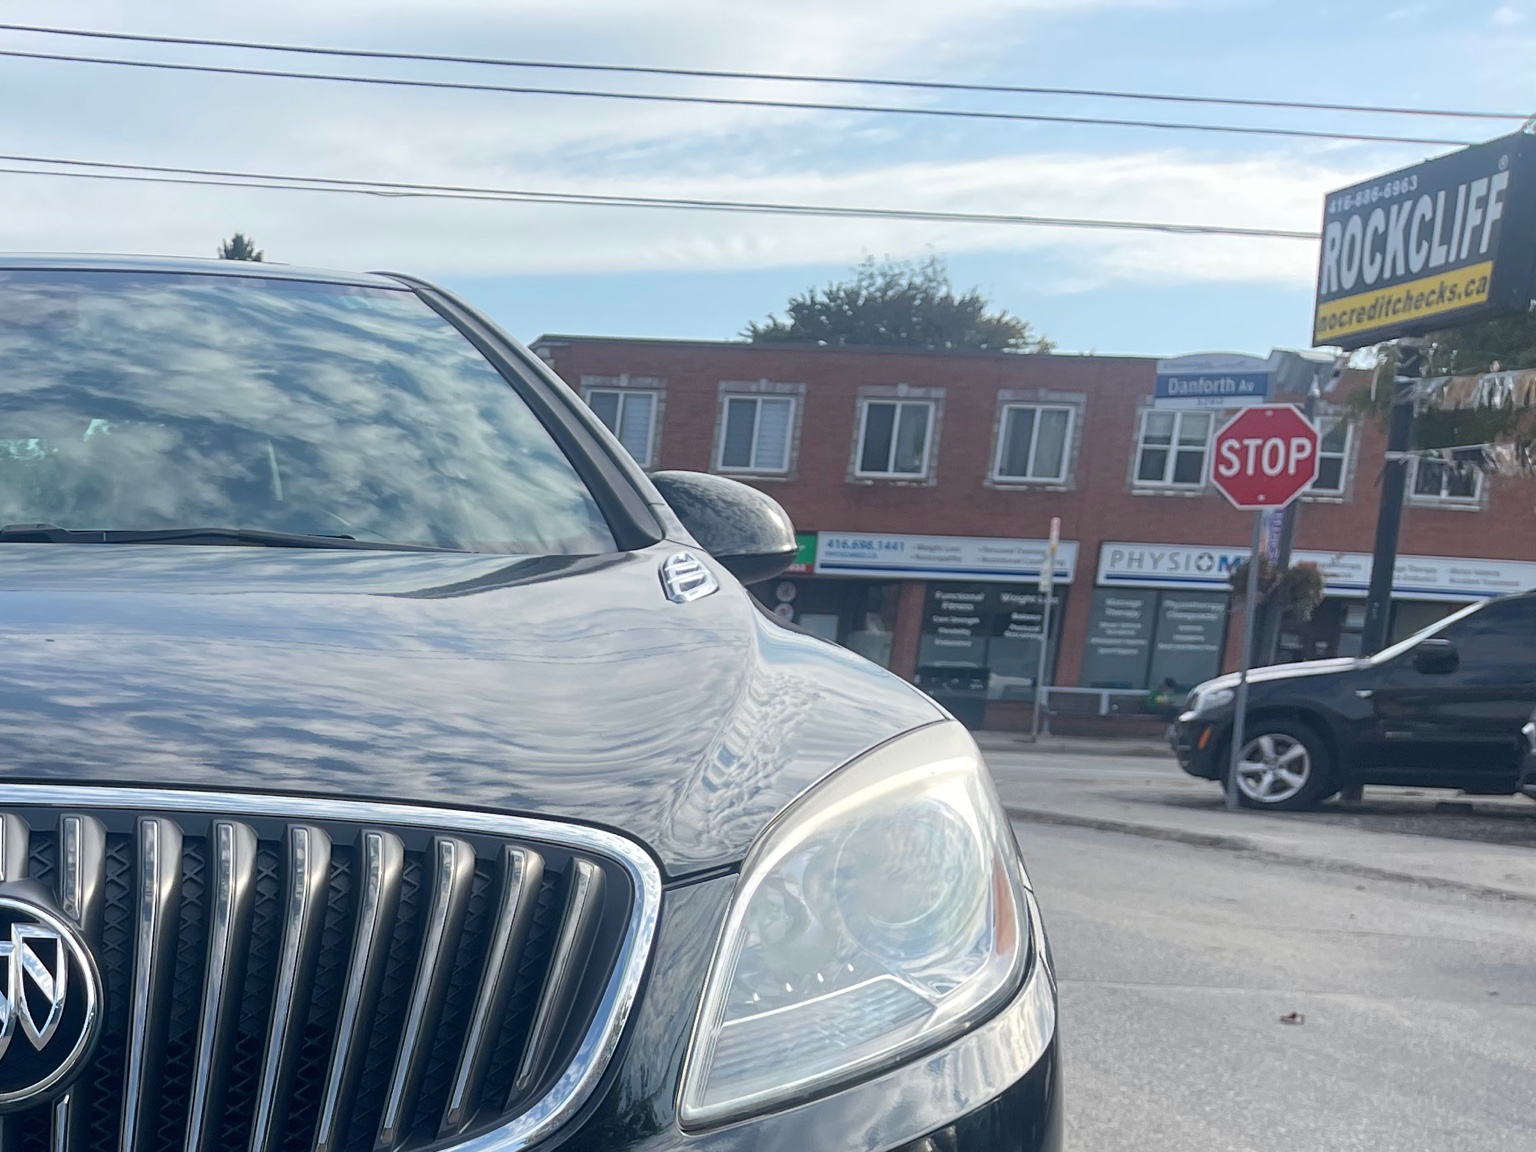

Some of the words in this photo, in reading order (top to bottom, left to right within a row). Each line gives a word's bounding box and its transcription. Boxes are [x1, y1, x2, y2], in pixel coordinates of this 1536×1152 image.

[1320, 170, 1509, 295] ROCKCLIFF
[1316, 274, 1488, 332] nocreditchecks.ca
[1167, 377, 1236, 395] Danforth
[1238, 379, 1255, 393] Av
[1218, 437, 1312, 477] STOP
